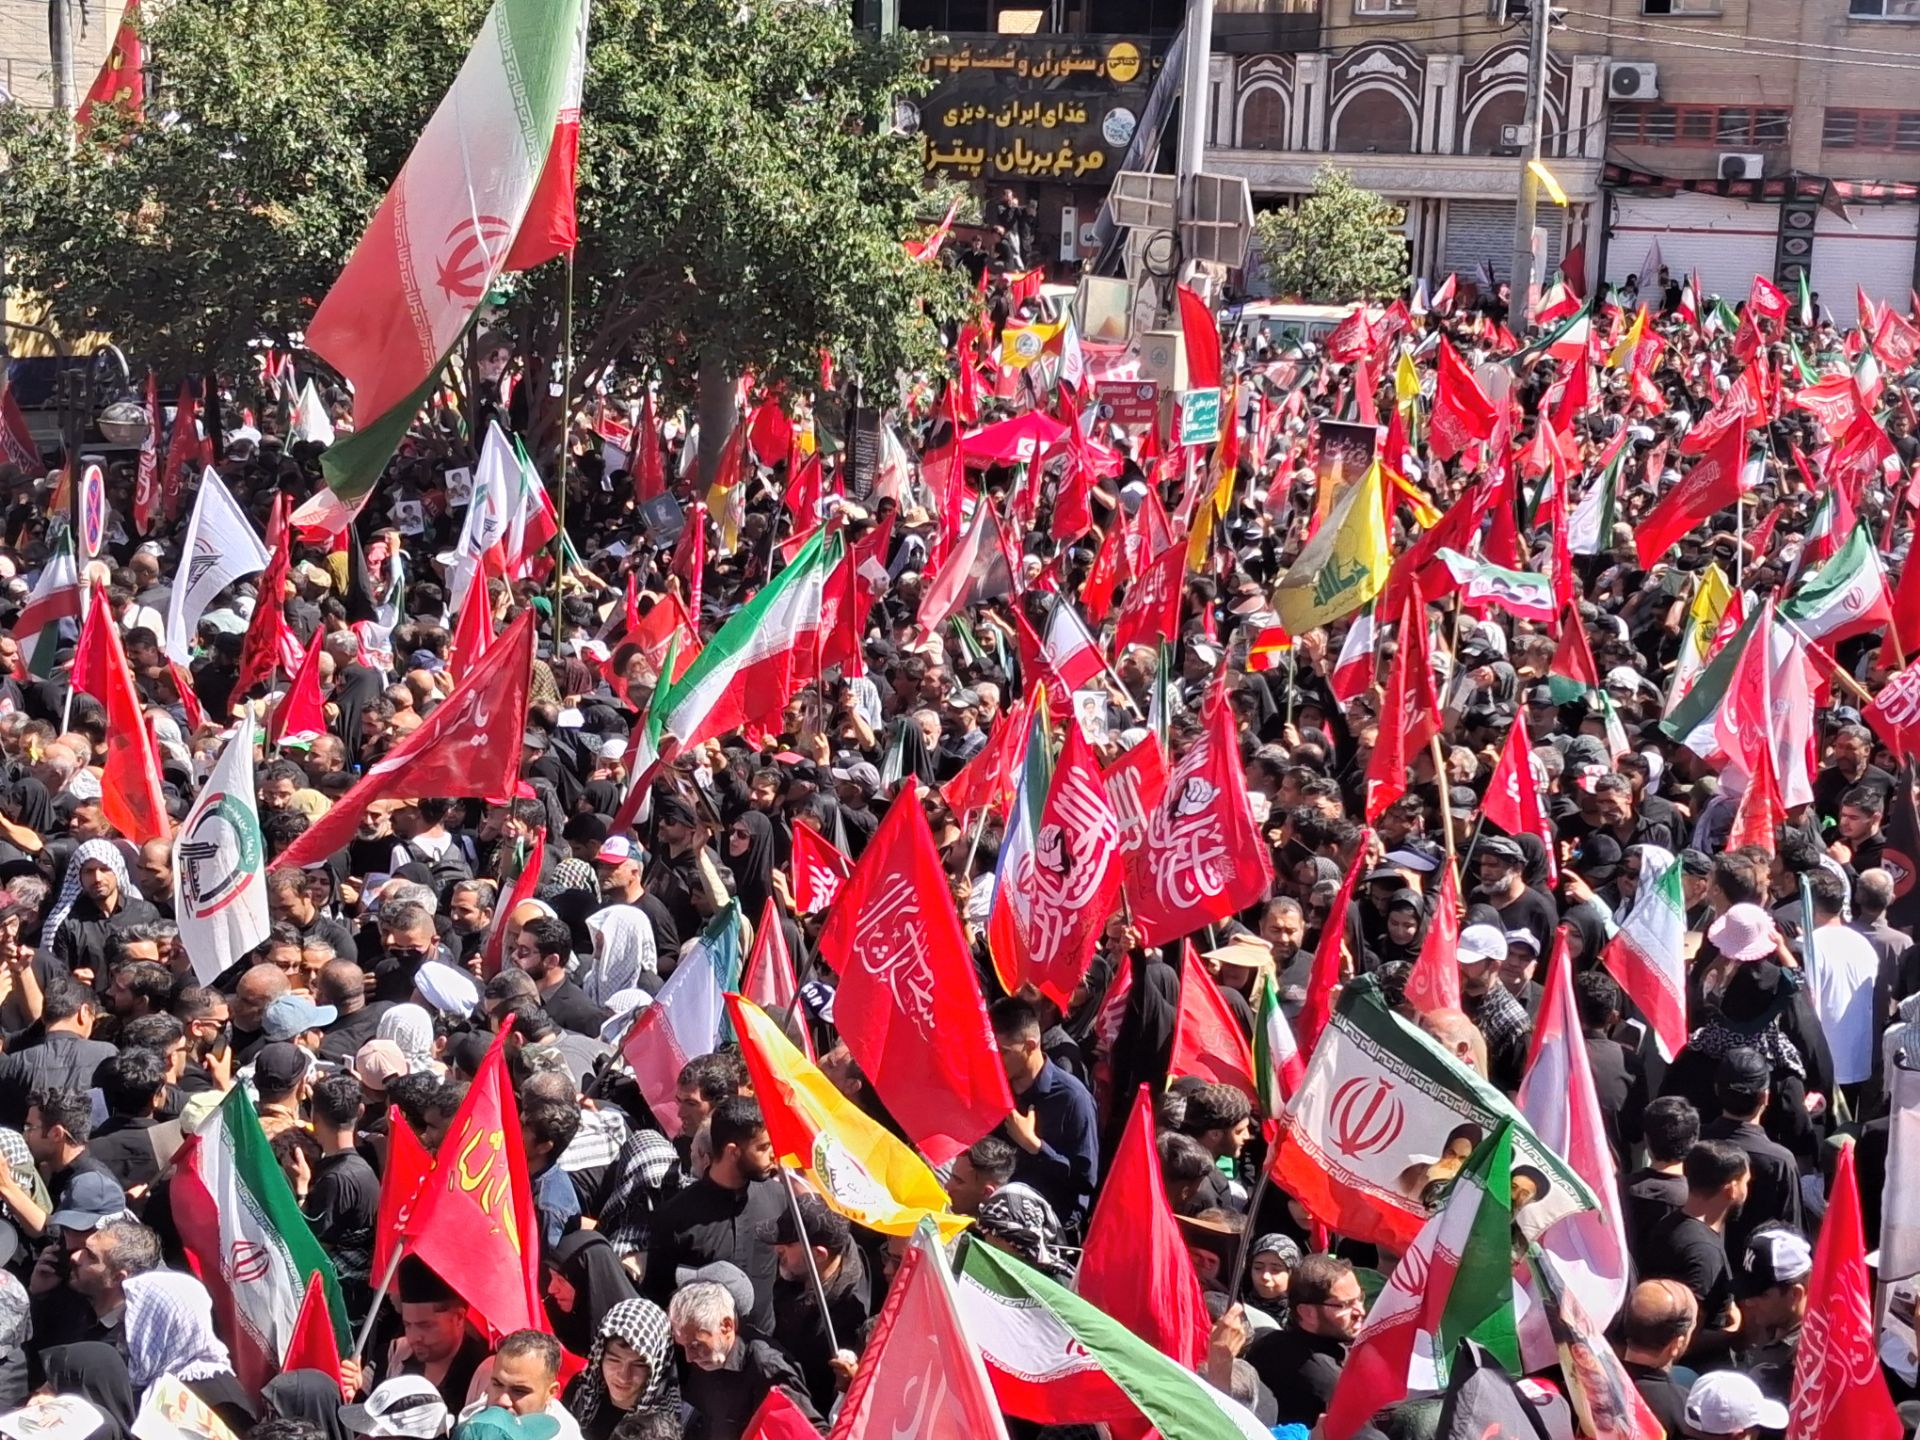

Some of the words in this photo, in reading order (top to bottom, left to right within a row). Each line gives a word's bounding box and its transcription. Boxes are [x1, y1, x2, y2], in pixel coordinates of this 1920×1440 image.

[1031, 47, 1105, 78] رستوران
[943, 101, 987, 128] دیزی
[995, 101, 1040, 129] ایرانی
[1041, 101, 1088, 128] غذای
[923, 138, 985, 178] پیتزا
[995, 138, 1054, 175] بریان
[1054, 138, 1104, 177] مرغ
